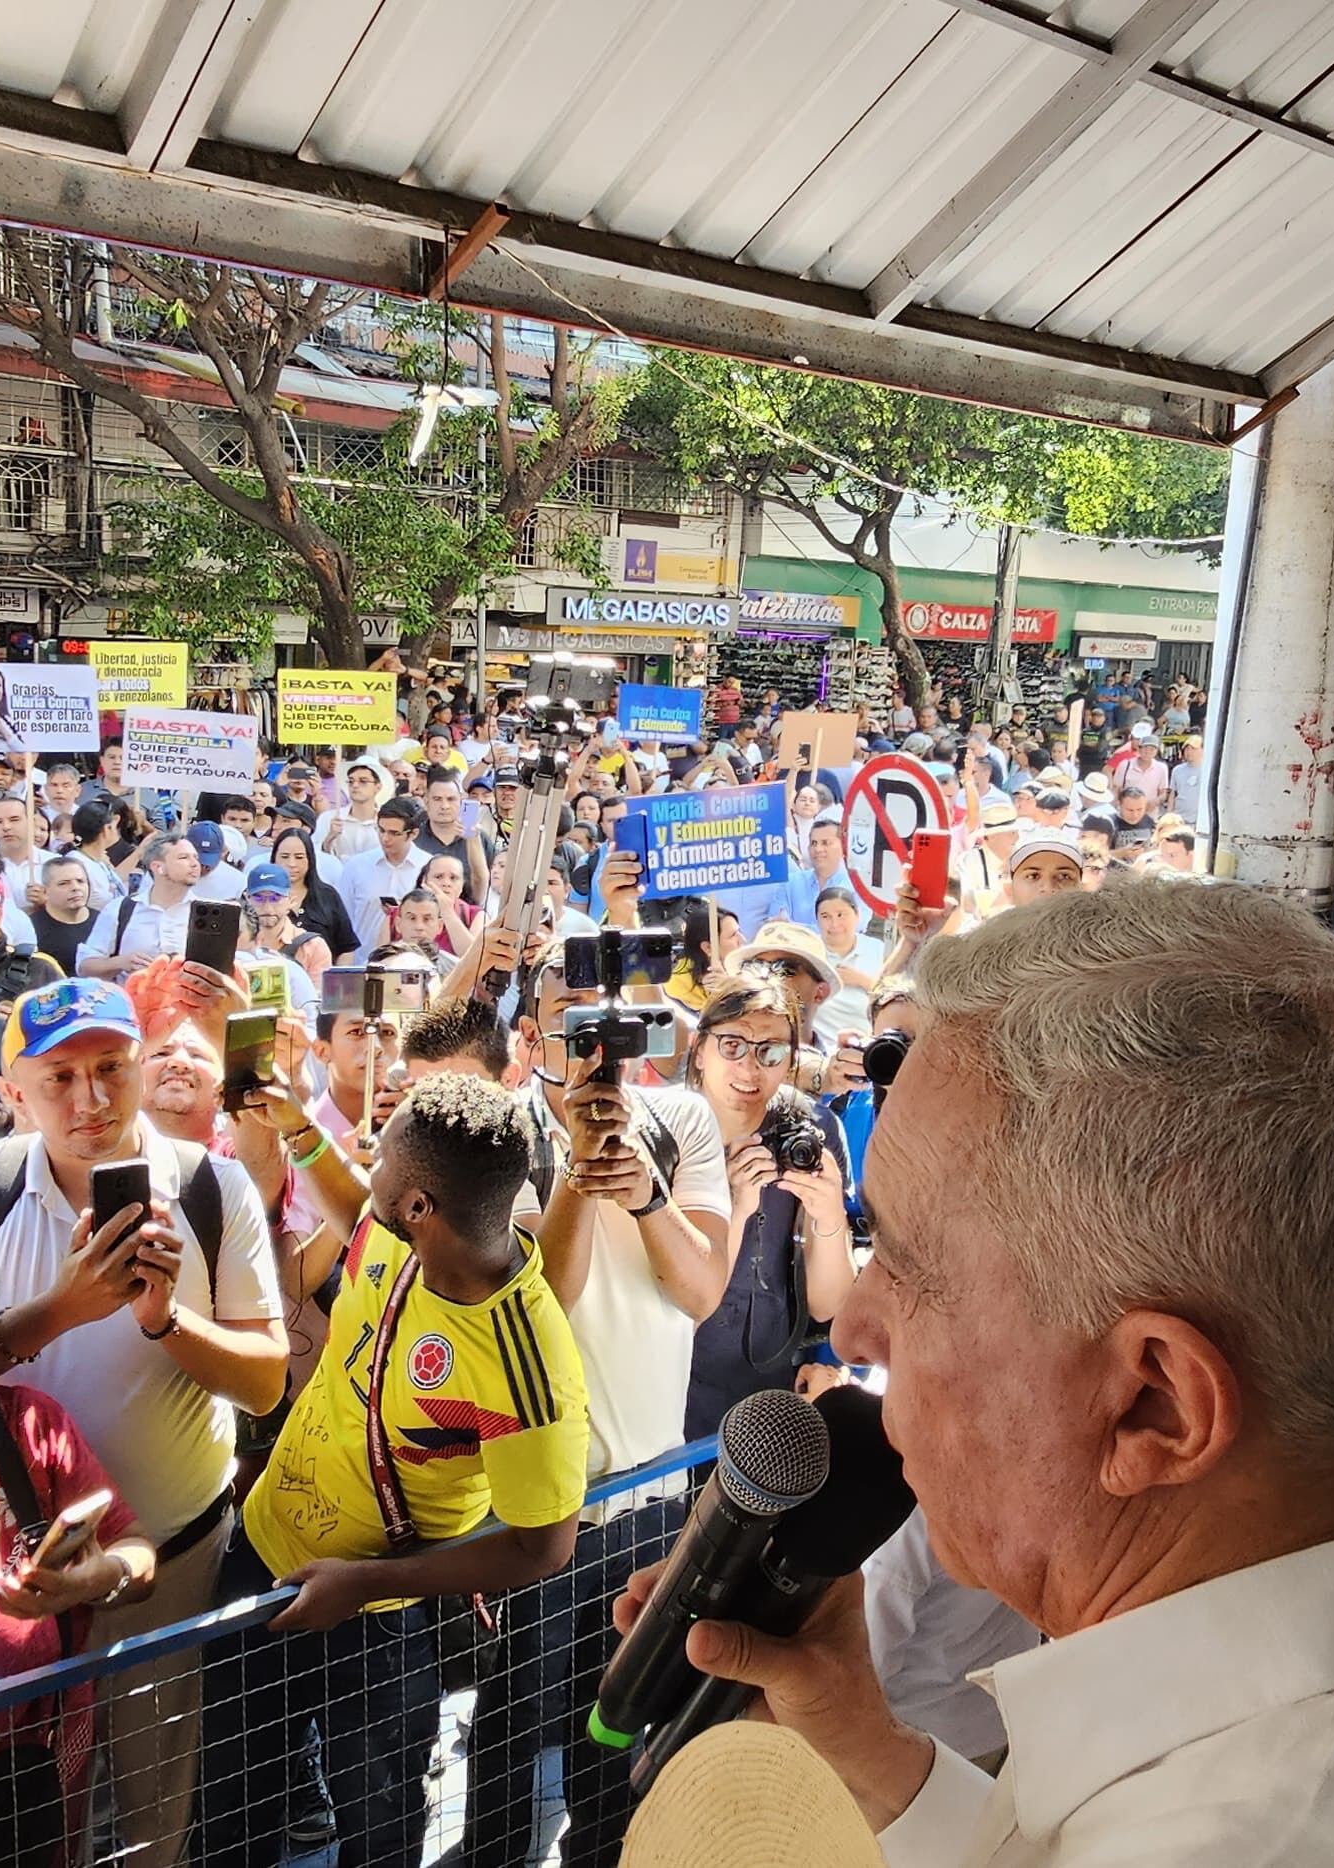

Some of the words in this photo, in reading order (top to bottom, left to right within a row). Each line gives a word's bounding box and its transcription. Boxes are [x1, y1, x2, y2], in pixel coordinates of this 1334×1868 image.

[565, 597, 731, 627] MEGABASICAS
[939, 610, 987, 631] CALZA
[536, 630, 665, 652] MEGABASICAS
[95, 652, 139, 666] Libertad,
[141, 653, 178, 666] justicia
[104, 666, 163, 678] democracia
[12, 683, 59, 699] Gracias,
[282, 678, 351, 691] ¡BASTA
[362, 680, 393, 692] YA!
[283, 695, 374, 705] VENEZUELA
[12, 710, 33, 723] por
[35, 709, 54, 721] ser
[56, 708, 69, 720] el
[71, 709, 94, 721] faro
[283, 704, 337, 713] QUIERE
[283, 713, 358, 723] LIBERTAD,
[14, 720, 28, 733] de
[30, 721, 91, 735] esperanza.
[128, 718, 210, 735] ¡BASTA
[219, 721, 254, 739] YA!
[283, 722, 305, 731] NO
[309, 723, 395, 732] DICTADURA.
[128, 732, 232, 749] VENEZUELA
[129, 743, 190, 756] QUIERE
[128, 753, 211, 768] LIBERTAD,
[156, 766, 252, 781] DICTADURA.
[652, 796, 704, 823] María
[711, 791, 768, 818] Corina
[655, 828, 669, 847] y
[671, 815, 762, 842] Edmundo:
[663, 834, 734, 868] fórmula
[738, 833, 762, 858] de
[767, 832, 783, 855] la
[655, 859, 771, 891] democracia.
